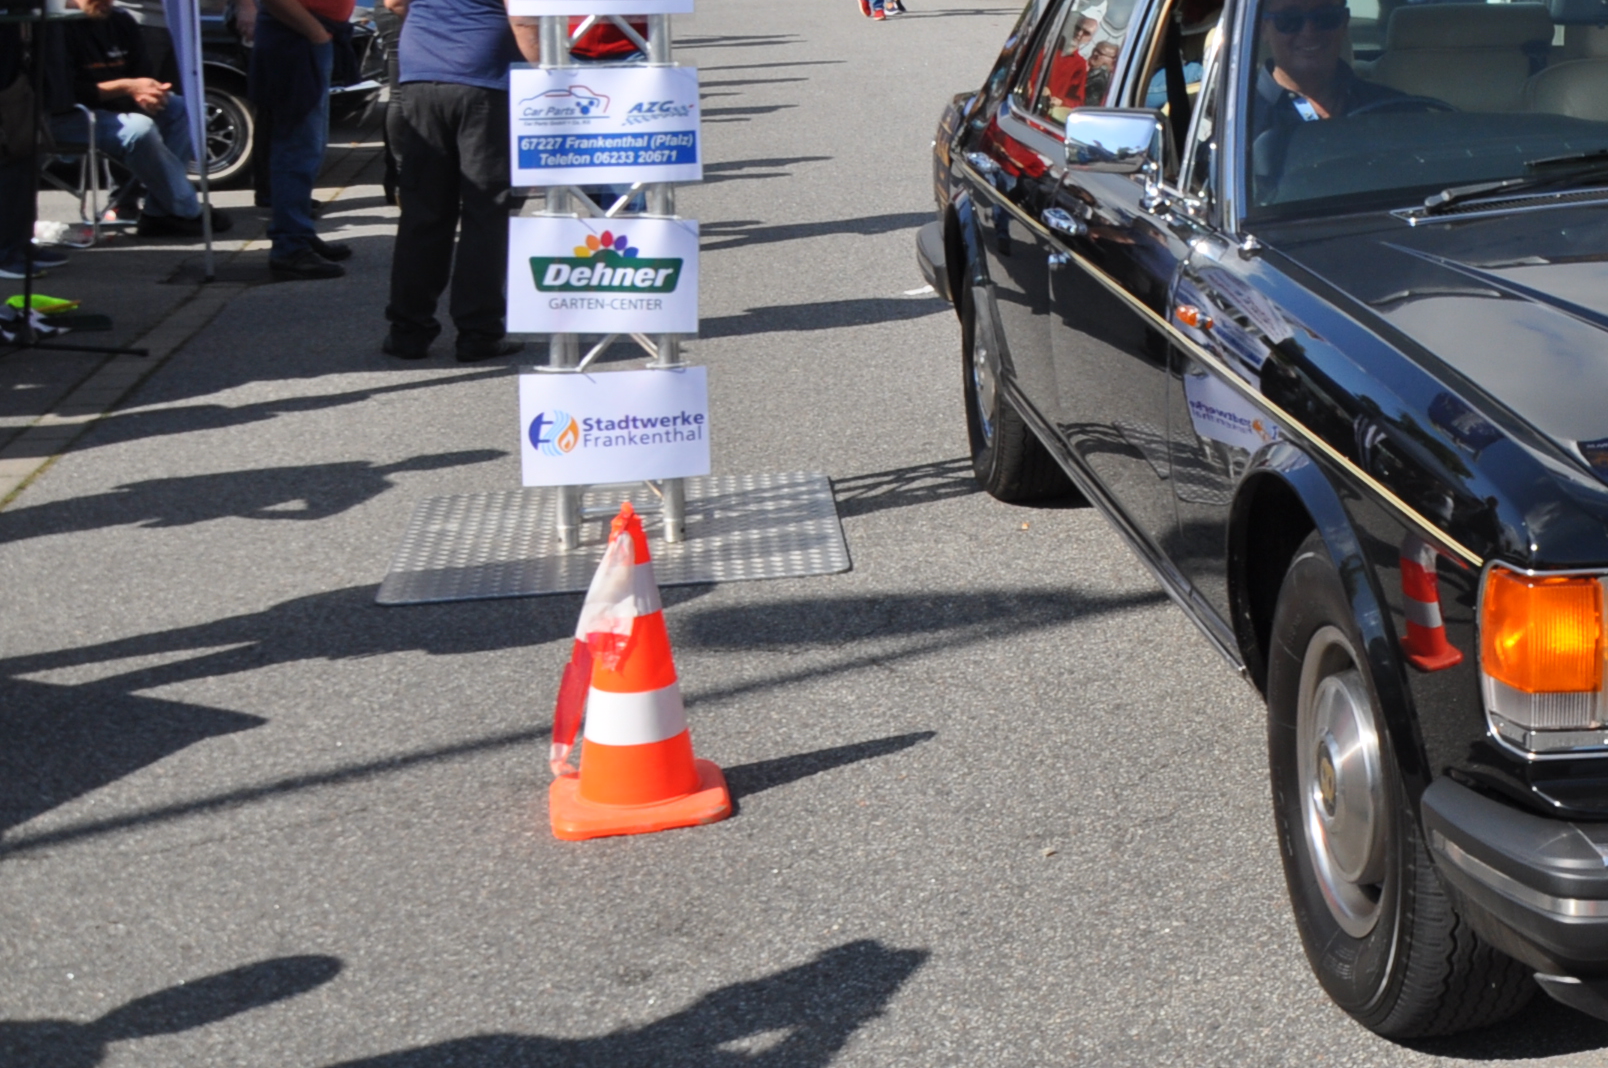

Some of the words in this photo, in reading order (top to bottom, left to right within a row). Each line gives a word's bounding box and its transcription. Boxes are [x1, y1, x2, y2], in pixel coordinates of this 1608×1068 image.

[523, 106, 543, 116] Car
[549, 106, 576, 116] Parts
[627, 100, 673, 114] AZG
[521, 138, 563, 151] 67227
[565, 135, 648, 149] Frankenthal
[651, 134, 693, 150] (Pfalz)
[539, 153, 590, 166] Telefon
[593, 151, 634, 164] 06233
[637, 150, 677, 163] 20671
[542, 262, 675, 288] Dehner
[549, 297, 663, 310] GARTEN-CENTER
[582, 410, 705, 432] Stadtwerke
[583, 425, 702, 448] Frankenthal
